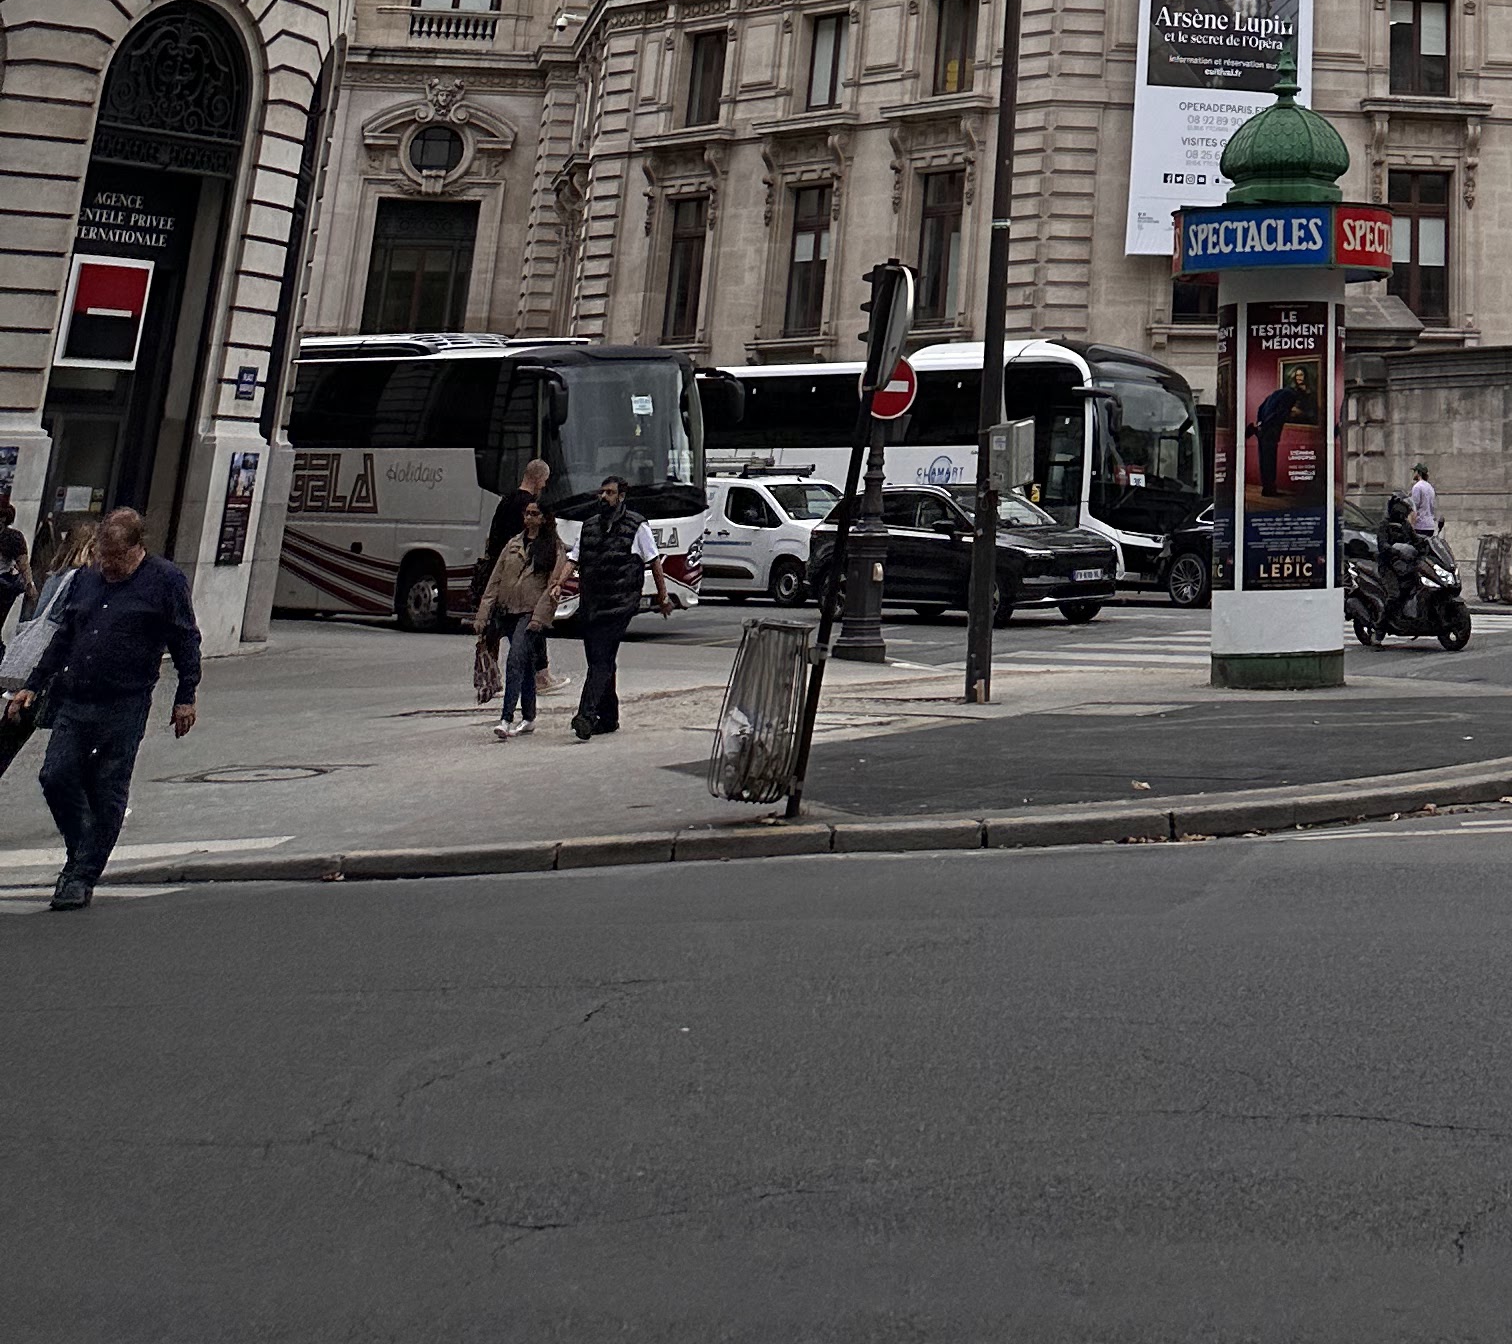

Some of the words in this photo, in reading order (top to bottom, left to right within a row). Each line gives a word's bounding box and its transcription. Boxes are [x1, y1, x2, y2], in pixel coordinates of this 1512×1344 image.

[1155, 6, 1229, 31] Arsène
[1164, 32, 1176, 42] et
[1178, 31, 1188, 43] le
[1190, 34, 1224, 46] secret
[1226, 34, 1240, 47] de
[1224, 59, 1264, 69] réservation
[1181, 137, 1217, 147] VISITES
[94, 192, 144, 210] AGENCE
[78, 225, 168, 247] ERNATIONALE
[1188, 218, 1323, 257] SPECTACLES
[1281, 311, 1298, 323] LE
[1251, 324, 1325, 337] TESTAMENT
[1262, 335, 1315, 350] MÉDICIS
[386, 462, 444, 490] Holidays
[1260, 563, 1313, 578] LEPIC
